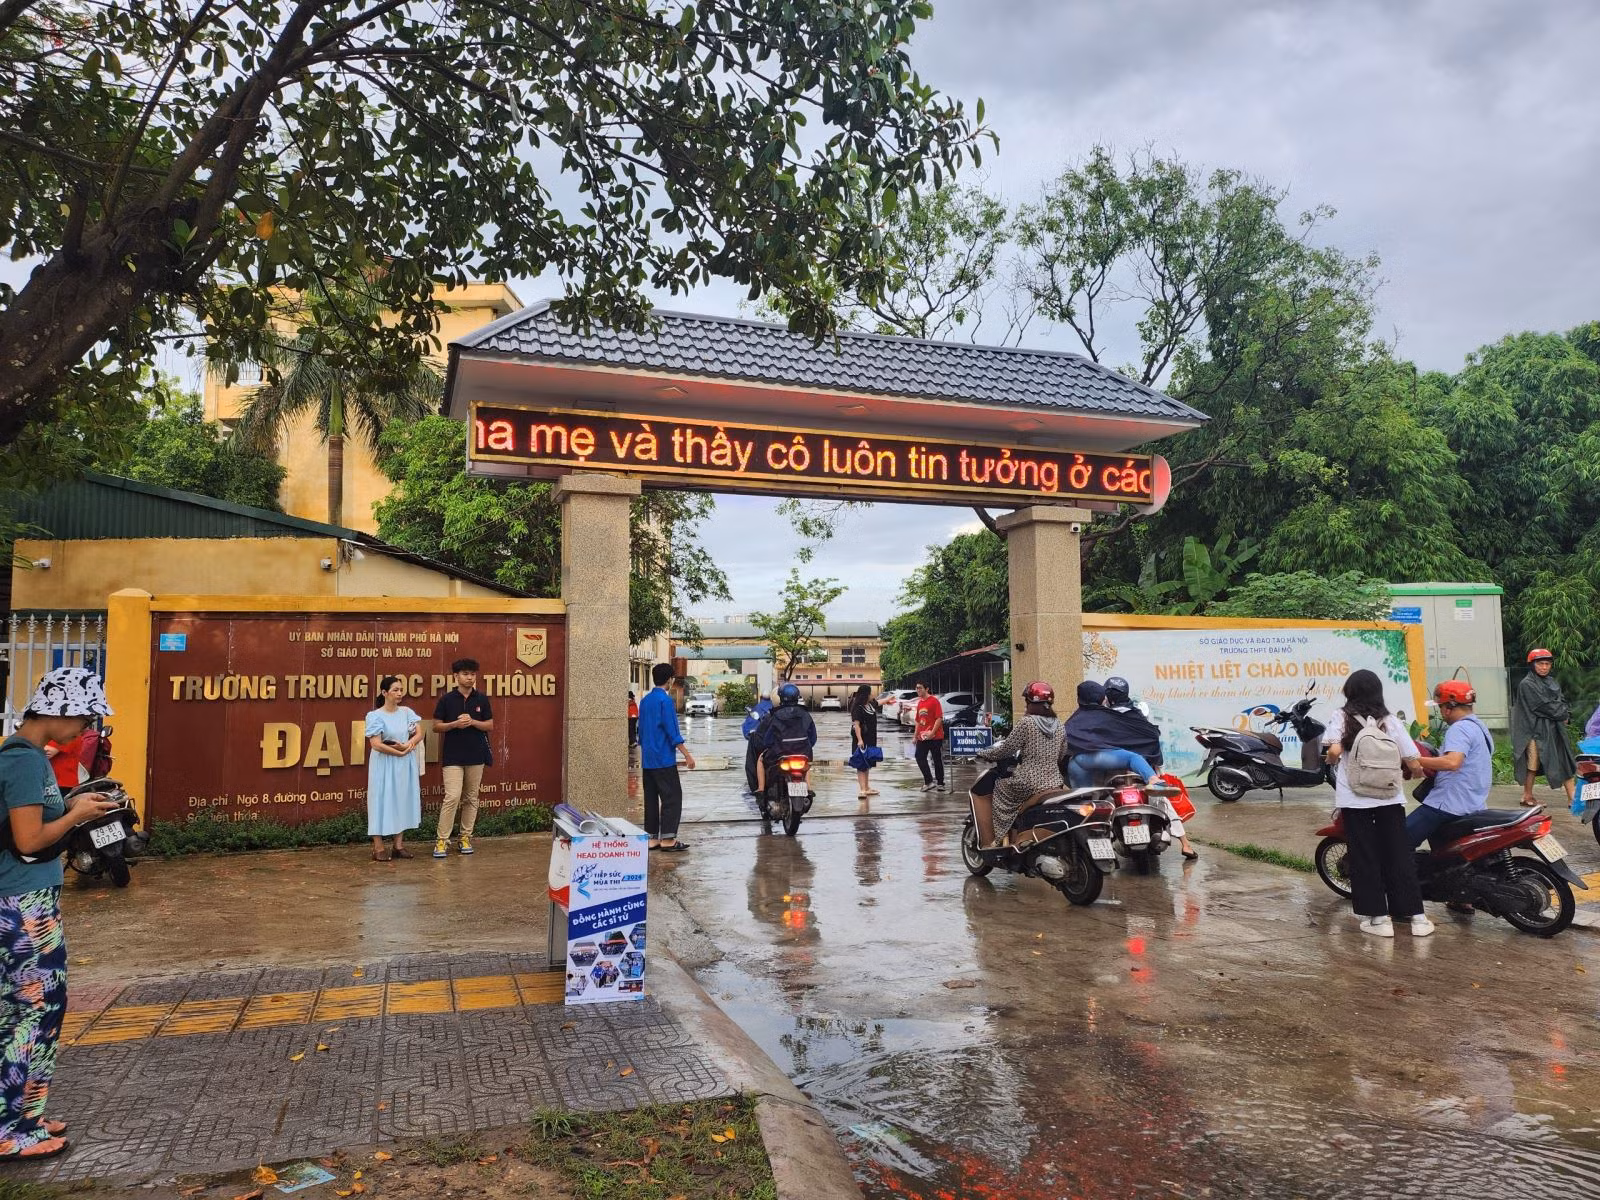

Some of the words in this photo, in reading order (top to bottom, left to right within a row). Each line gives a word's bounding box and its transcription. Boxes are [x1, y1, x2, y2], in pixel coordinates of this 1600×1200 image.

[530, 424, 596, 462] mẹ
[609, 423, 658, 461] và
[671, 425, 753, 472] thầy
[766, 436, 811, 471] cô
[823, 439, 896, 476] luôn
[908, 447, 948, 480] tin
[959, 449, 1059, 493] tưởng
[1069, 454, 1092, 489] ở
[304, 631, 324, 642] BAN
[377, 630, 407, 643] THÀNH
[409, 630, 427, 643] PHỐ
[430, 631, 442, 643] HÀ
[337, 646, 357, 658] GIÁO
[382, 646, 393, 658] VÀ
[1154, 659, 1205, 684] NHIỆT
[1210, 659, 1242, 683] LIỆT
[1247, 658, 1299, 679] CHÀO
[1303, 658, 1350, 678] MỪNG
[170, 669, 277, 700] TRƯỜNG
[284, 675, 369, 699] TRUNG
[483, 669, 556, 697] THÔNG
[188, 796, 207, 809] Địa
[274, 791, 307, 805] đường
[310, 790, 344, 803] Quang
[94, 823, 117, 838] 29-B1
[95, 831, 124, 847] 507.53
[603, 840, 629, 849] THỐNG
[599, 851, 625, 859] DOANH
[593, 878, 608, 886] MÙA
[572, 913, 597, 926] ĐỒNG
[597, 906, 622, 919] HÀNH
[622, 899, 645, 911] CÙNG
[592, 919, 608, 929] CÁC
[618, 912, 630, 922] TỬ
